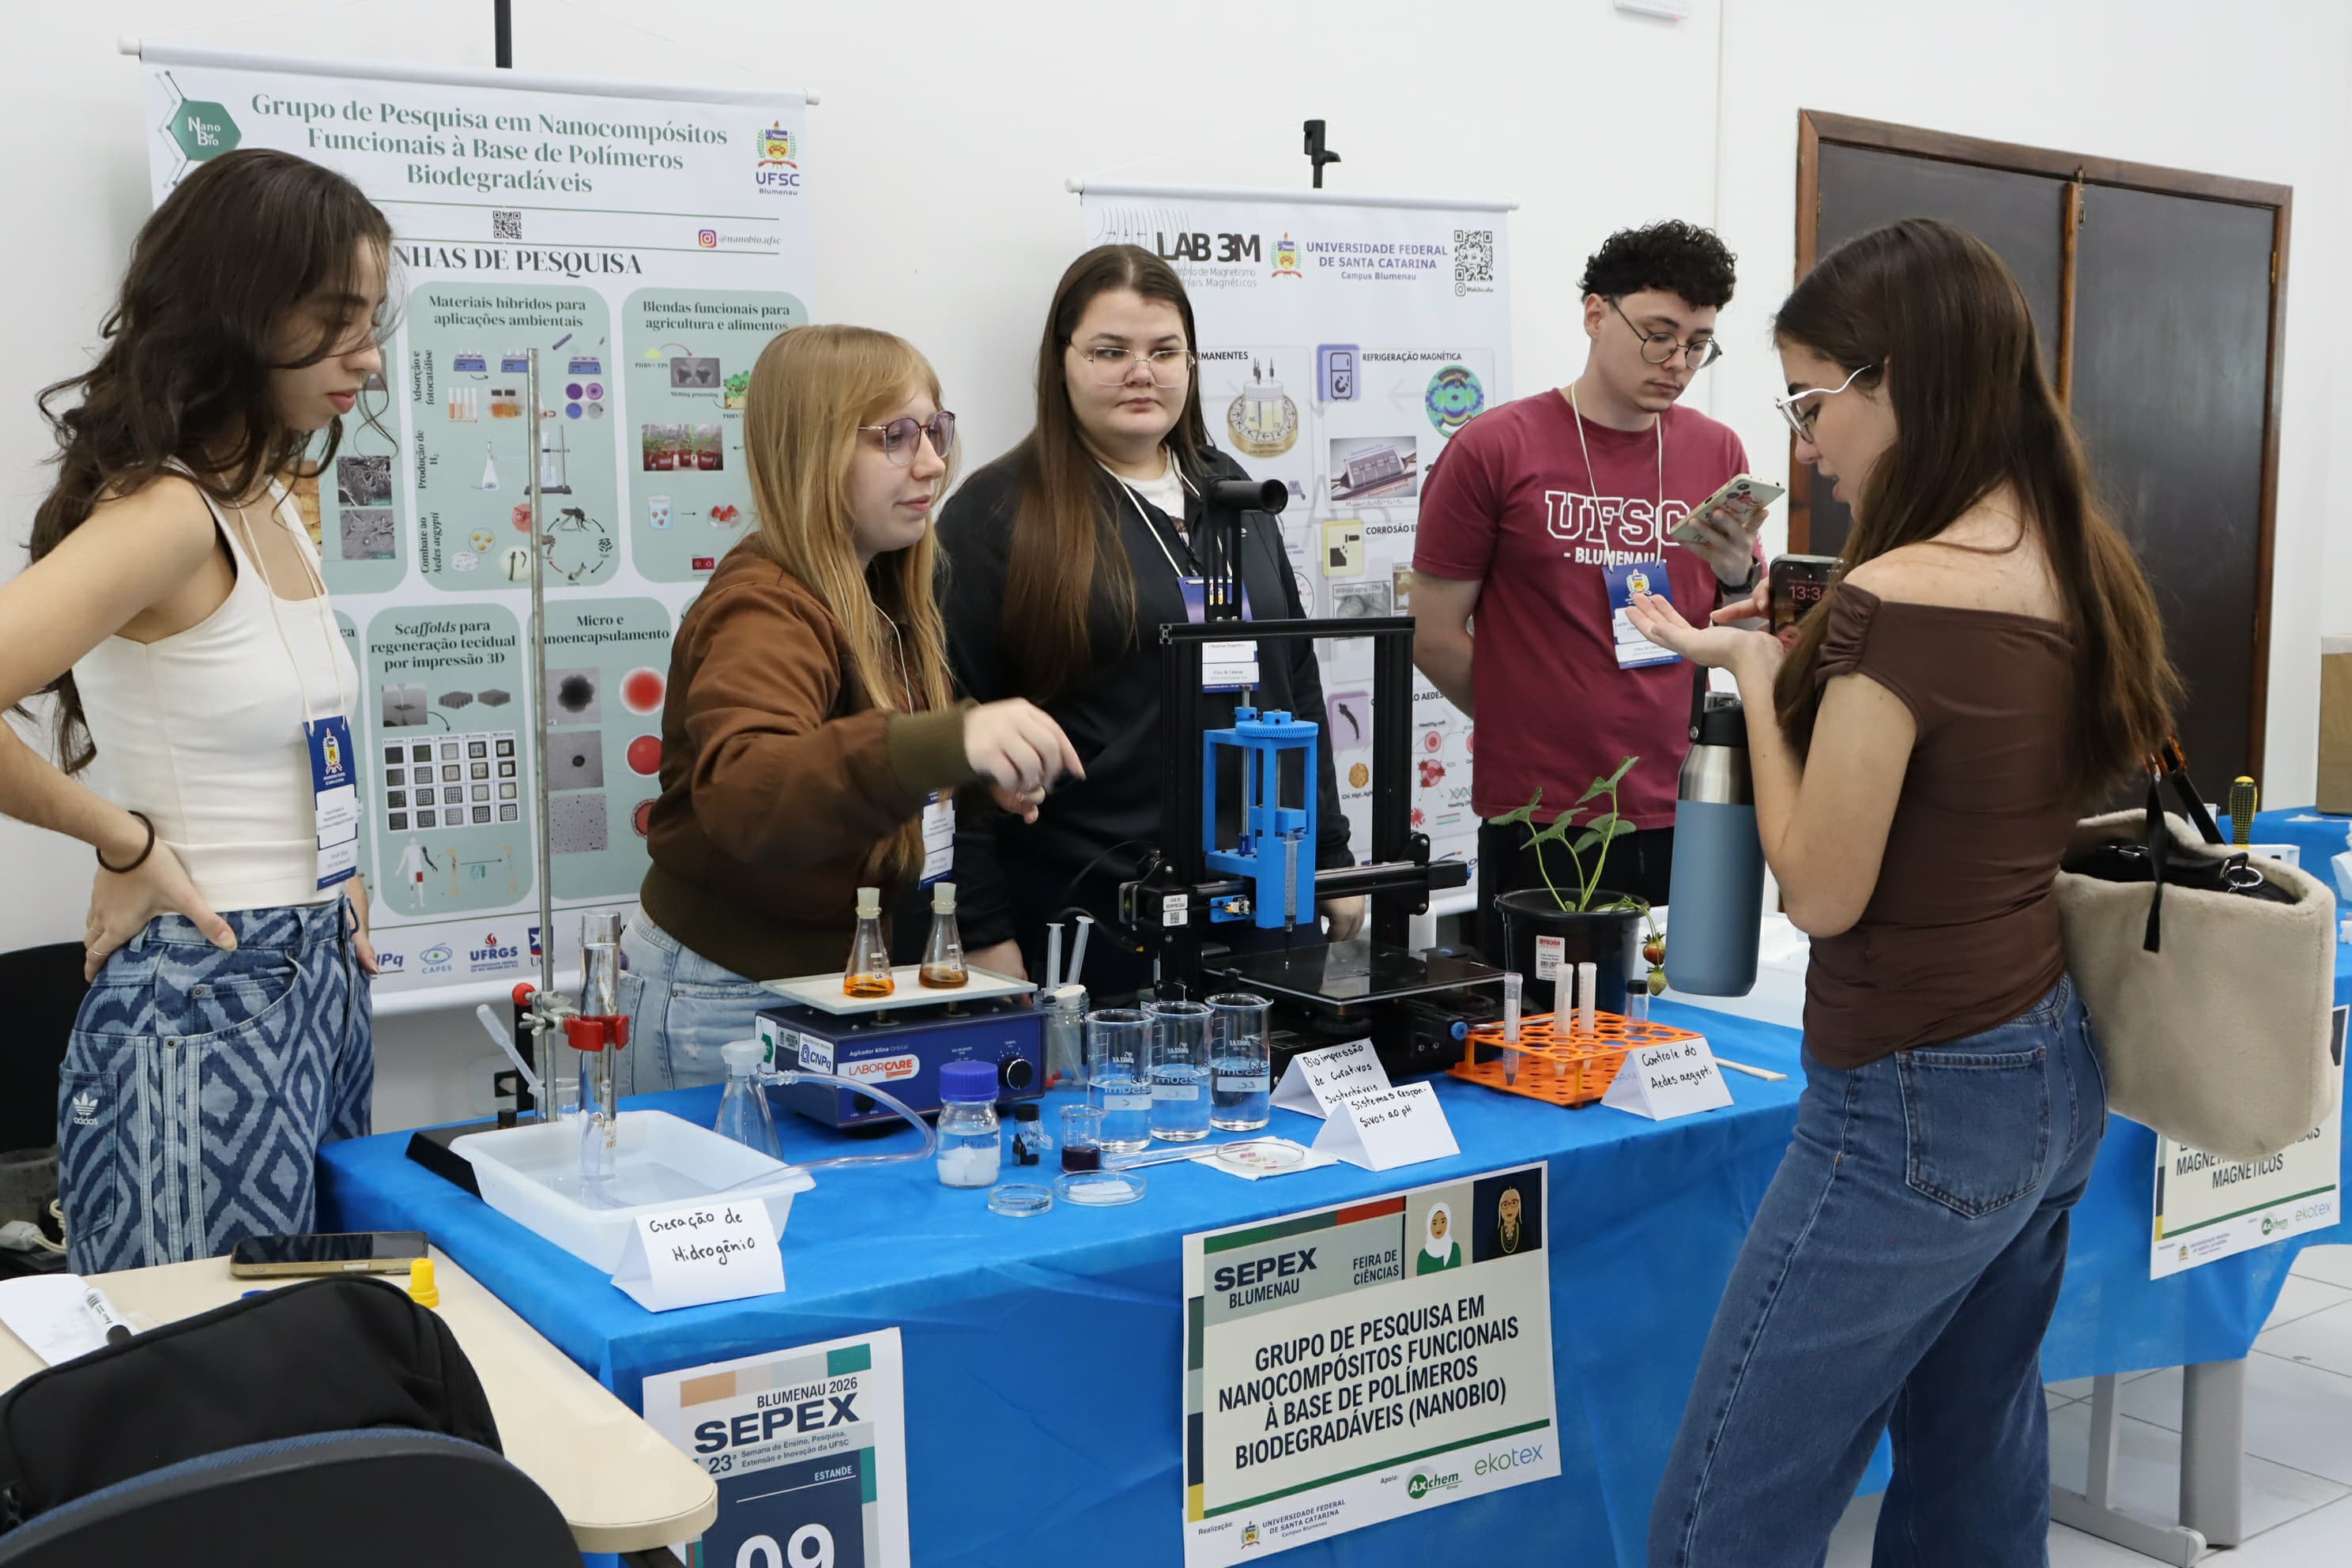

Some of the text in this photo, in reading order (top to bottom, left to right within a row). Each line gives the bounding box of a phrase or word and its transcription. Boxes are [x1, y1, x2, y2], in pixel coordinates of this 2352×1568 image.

[188, 116, 221, 133] Nano
[251, 93, 728, 146] Grupo de Pesquisa em Nanocompósitos
[197, 128, 220, 147] Bio
[308, 127, 684, 170] Funcionais à Base de Polímeros
[406, 163, 593, 194] Biodegradáveis
[756, 172, 801, 187] UFSC
[759, 187, 798, 196] Blumenau
[718, 236, 782, 247] @nanobio.ufsc
[1156, 232, 1261, 262] LAB 3M
[1306, 242, 1448, 255] UNIVERSIDADE FEDERAL
[392, 247, 643, 278] NHAS DE PESQUISA
[1210, 267, 1257, 278] Magnetismo
[1319, 257, 1437, 269] DE SANTA CATARINA
[1206, 277, 1258, 289] Magnéticos
[1341, 272, 1416, 281] Campus Blumenau
[429, 296, 586, 314] Materiais híbridos para
[643, 300, 790, 317] Blendas funcionais para
[434, 313, 583, 327] aplicações ambientais
[645, 318, 714, 331] agricultura
[727, 319, 789, 331] alimentos
[1197, 351, 1249, 360] RMANENTES
[1363, 352, 1462, 364] REFRIGERAÇÃO MAGNÉTICA
[413, 360, 423, 404] Adsorção
[423, 349, 435, 405] fotocatálise
[416, 429, 427, 489] Produção de
[1545, 490, 1691, 546] UFSC
[1366, 522, 1409, 535] CORROSÃO
[420, 516, 429, 574] Combate ao
[433, 544, 442, 575] Aedes
[1574, 547, 1657, 565] BLUMENAU
[1788, 585, 1822, 601] 13:3
[394, 620, 491, 638] Scaffolds para
[576, 614, 624, 628] Micro e
[371, 635, 516, 655] regeneração tecidual
[384, 652, 505, 673] por impressão 3D
[469, 946, 518, 962] UFRGS
[421, 964, 453, 974] CAPES
[810, 1051, 831, 1072] CNPq
[849, 1049, 874, 1057] Agitador
[1642, 1046, 1697, 1068] Controle do
[849, 1059, 913, 1076] LABORCARE
[1314, 1076, 1325, 1087] de
[1651, 1072, 1678, 1090] Aedes
[1351, 1091, 1396, 1110] Sistemas
[74, 1115, 99, 1125] adidas
[1401, 1106, 1413, 1118] pH
[649, 1207, 743, 1233] Geração de
[2294, 1200, 2332, 1223] ekotex
[672, 1237, 756, 1266] Hidrogênio
[1352, 1249, 1398, 1271] FEIRA DE
[1213, 1246, 1318, 1293] SEPEX
[1353, 1265, 1400, 1286] CIÊNCIAS
[1228, 1277, 1300, 1309] BLUMENAU
[1255, 1294, 1486, 1372] GRUPO DE PESQUISA EM
[1218, 1314, 1520, 1413] NANOCOMPÓSITOS FUNCIONAIS
[757, 1376, 858, 1408] BLUMENAU 2026
[1265, 1355, 1479, 1432] À BASE DE POLÍMEROS
[694, 1392, 861, 1454] SEPEX
[1234, 1376, 1507, 1470] BIODEGRADÁVEIS (NANOBIO)
[741, 1430, 847, 1458] Semana de Ensino, Pesquisa,
[741, 1455, 775, 1468] Extensão
[783, 1446, 816, 1461] Inovação
[817, 1442, 828, 1453] da
[829, 1438, 850, 1449] UFSC
[1474, 1444, 1544, 1476] ekotex
[814, 1465, 853, 1482] ESTANDE
[1380, 1474, 1399, 1484] Apoio:
[1409, 1472, 1460, 1494] Axchem
[1262, 1499, 1346, 1528] UNIVERSIDADE FEDERAL
[1269, 1509, 1340, 1535] DE SANTA CATARINA
[1281, 1521, 1328, 1538] Campus Blumenau
